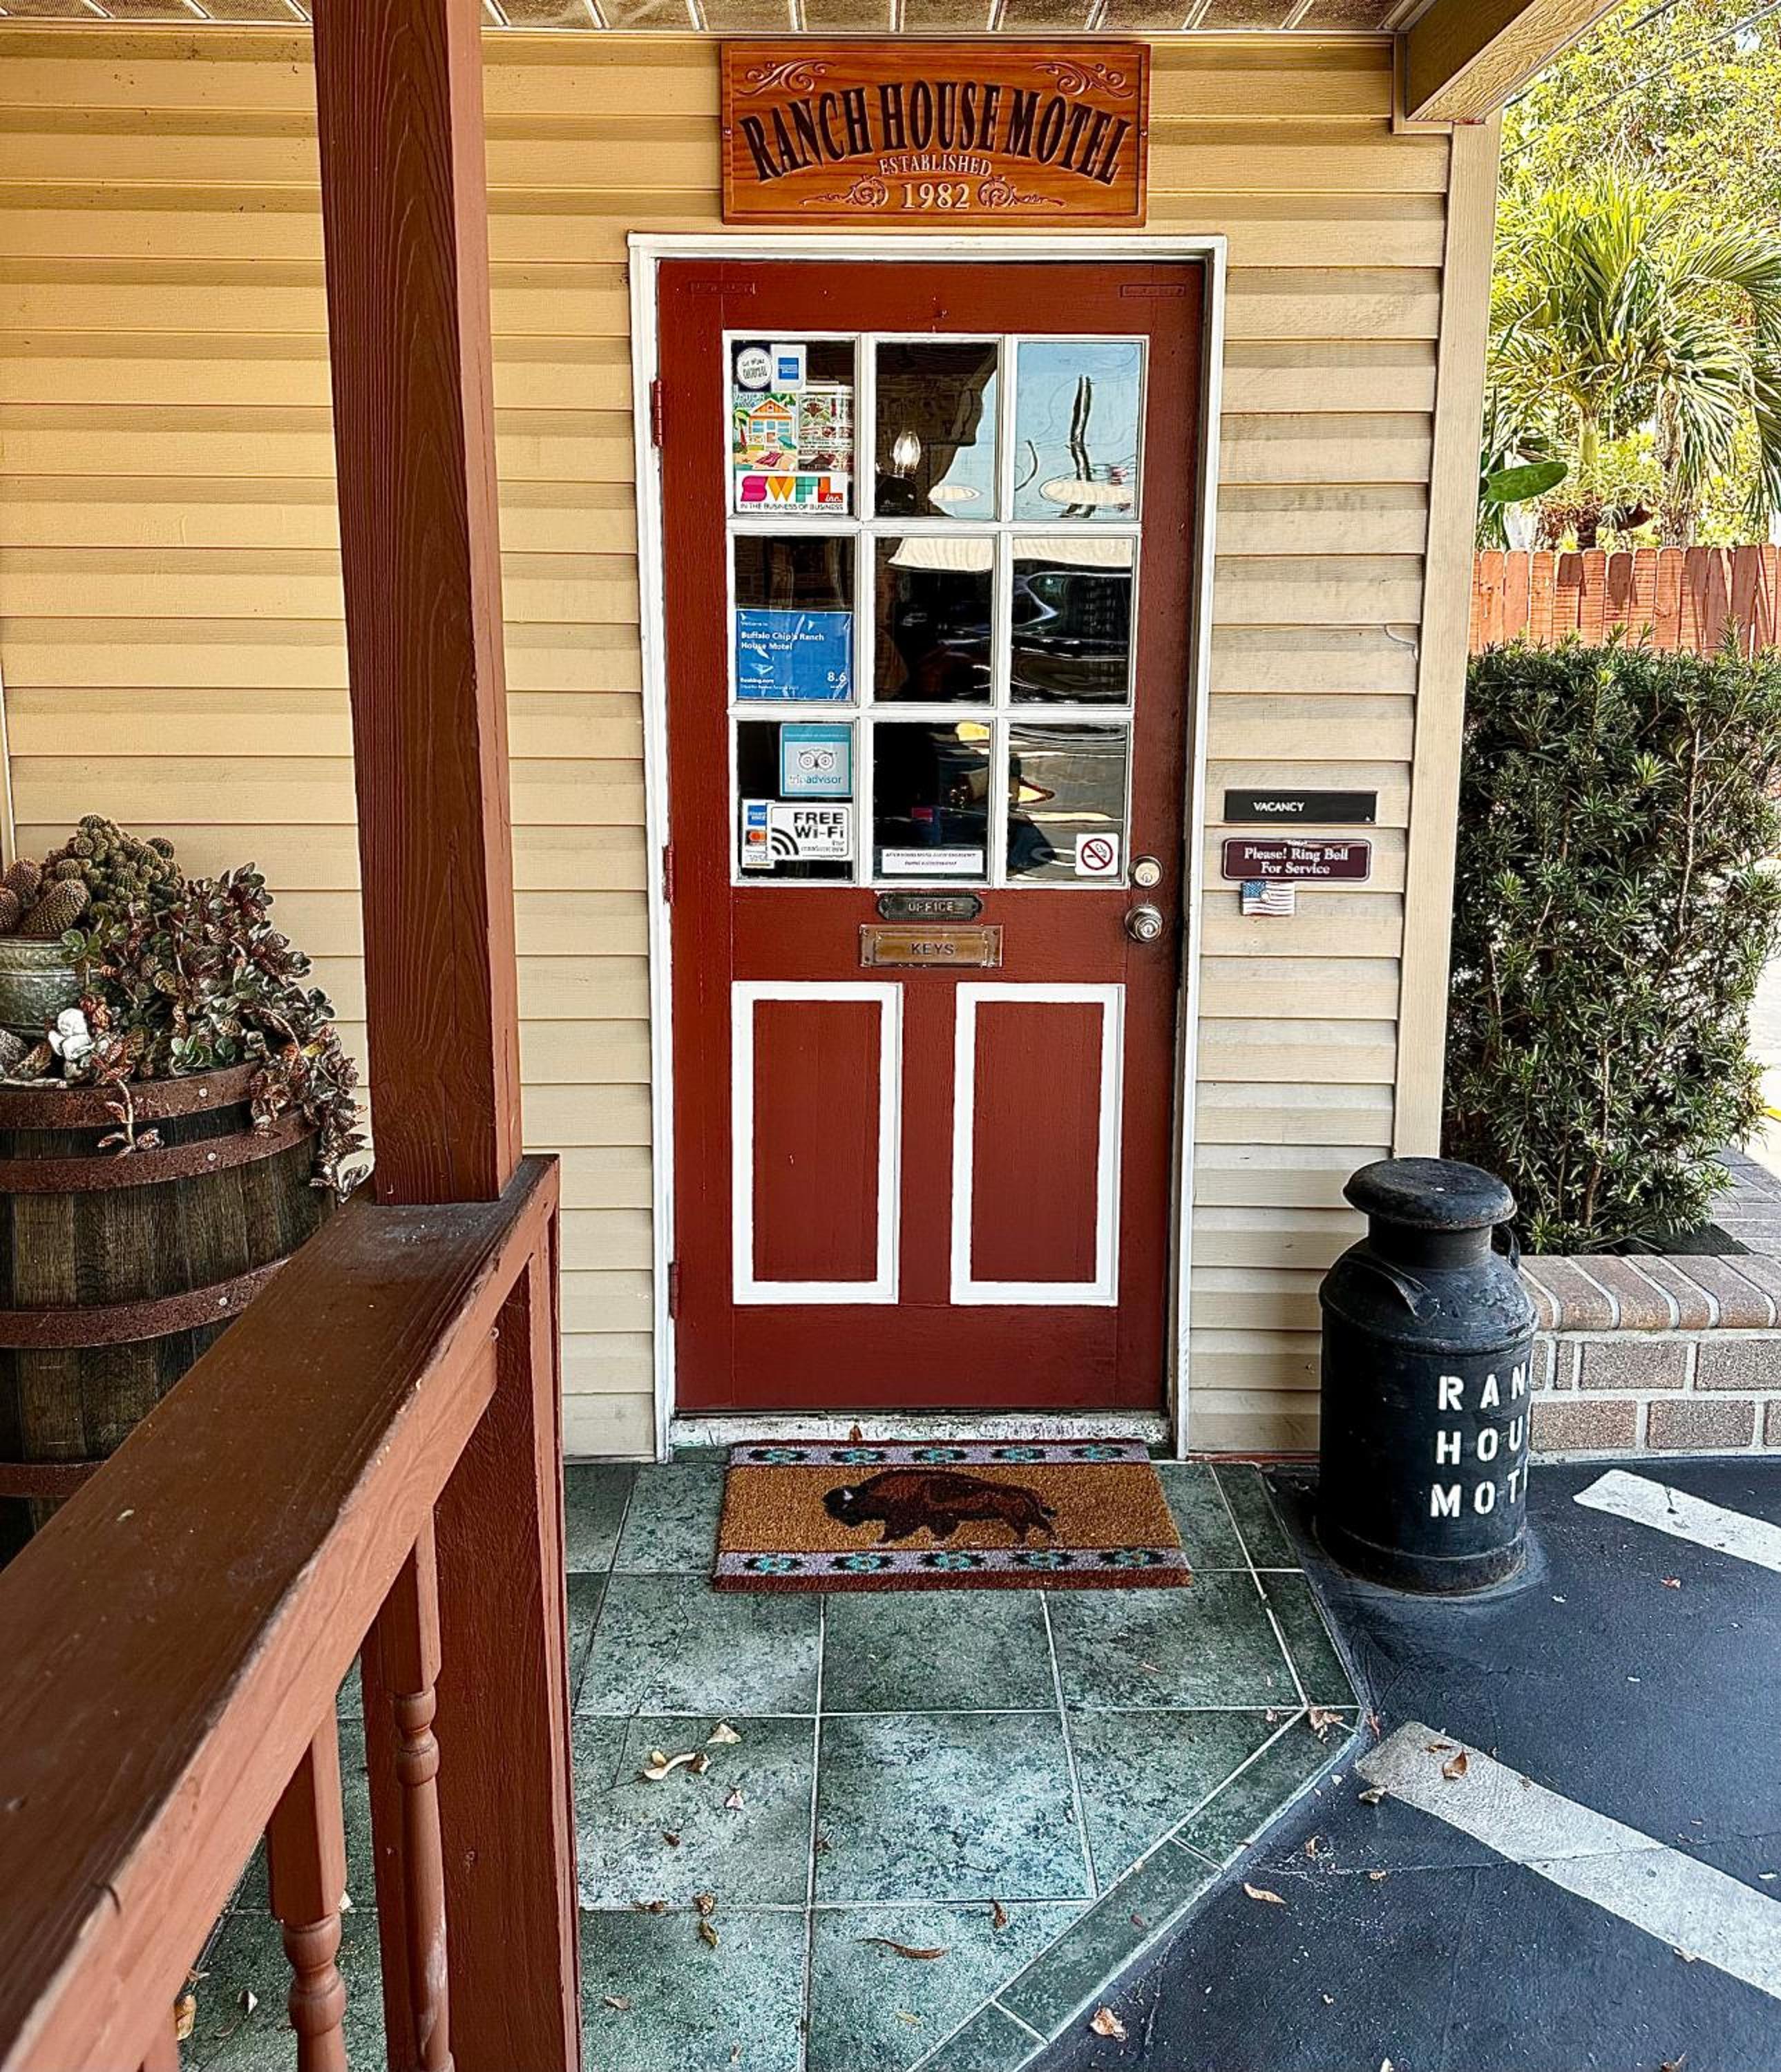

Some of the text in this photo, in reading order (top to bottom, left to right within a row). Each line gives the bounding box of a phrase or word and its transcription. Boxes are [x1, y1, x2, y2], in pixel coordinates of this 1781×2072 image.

[739, 80, 1133, 186] RANCH HOUSE MOTEL
[879, 153, 992, 177] ESTABLISHED
[902, 182, 971, 209] 1982
[741, 475, 844, 503] SWFL
[741, 631, 770, 639] Buffalo
[799, 633, 824, 641] Ranch
[827, 671, 846, 682] 8.6
[1253, 802, 1305, 812] VACANCY
[794, 812, 844, 824] FREE
[794, 825, 844, 838] Wi-Fi
[1244, 847, 1349, 862] Please! Ring Bell
[1261, 861, 1331, 874] For Service
[908, 902, 953, 911] OFFICE
[911, 943, 954, 955] KEYS
